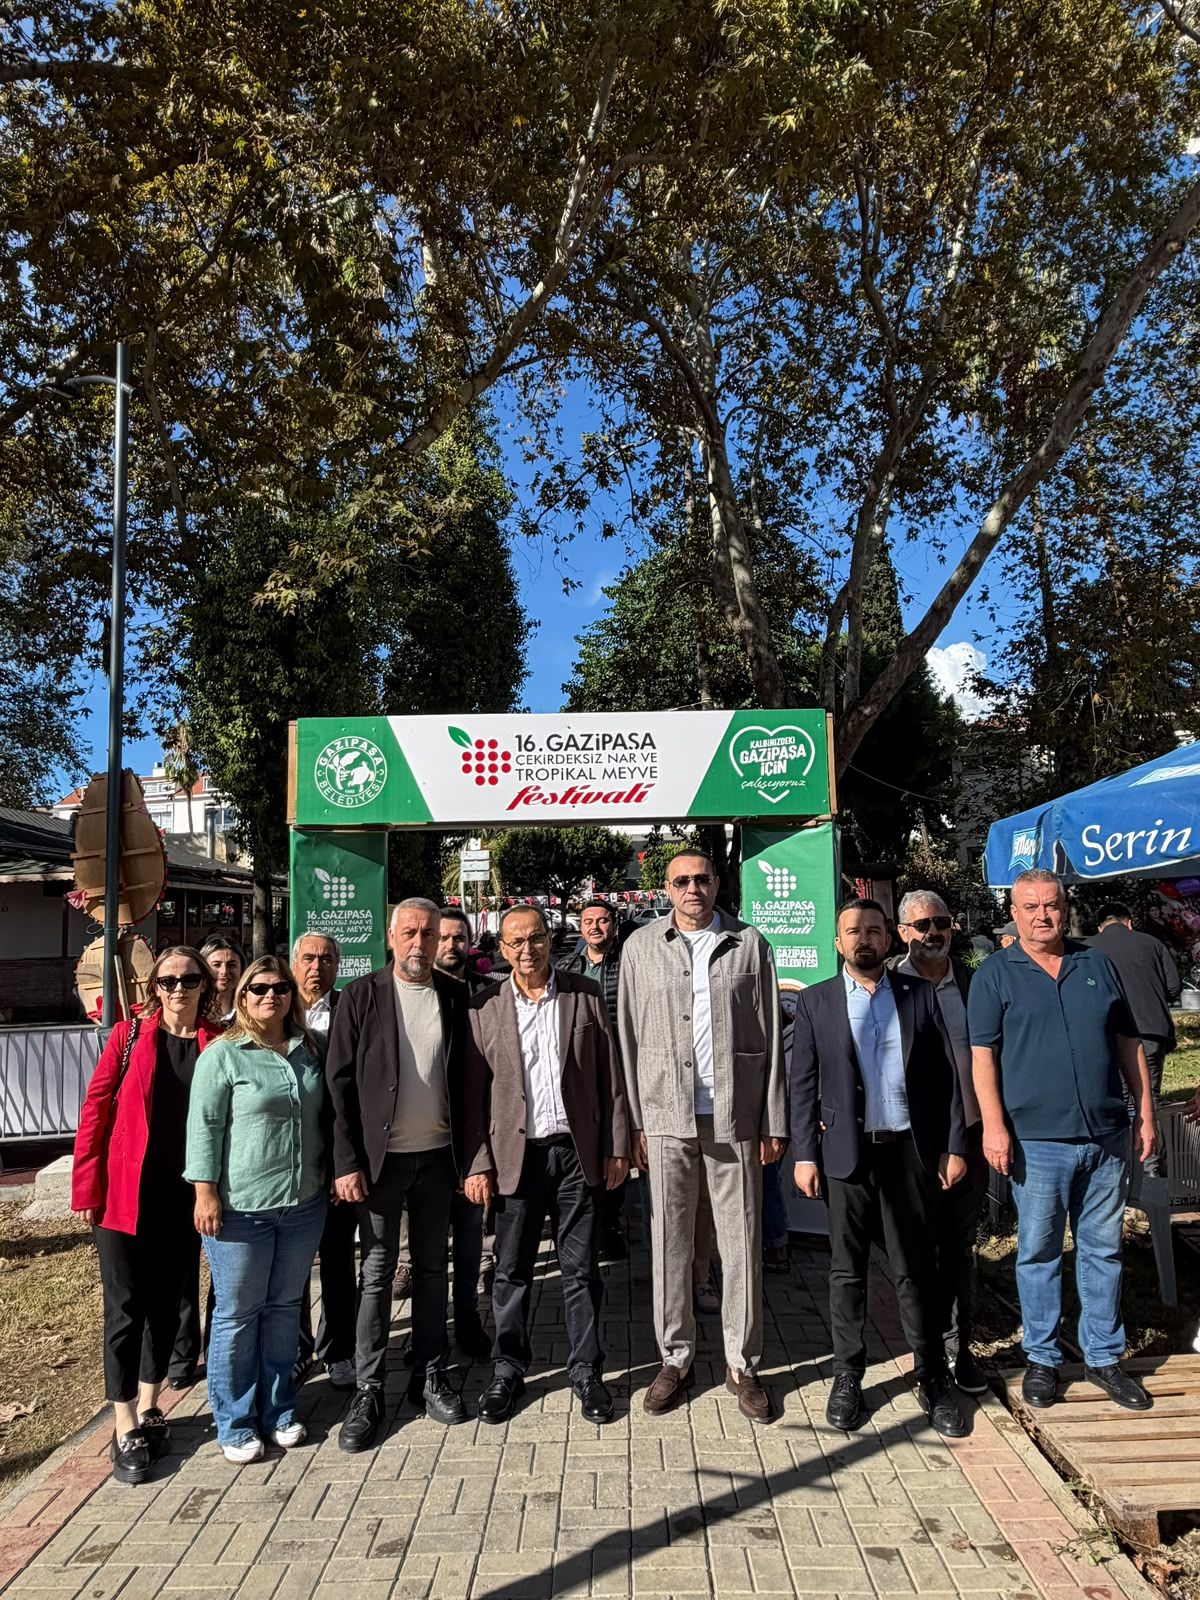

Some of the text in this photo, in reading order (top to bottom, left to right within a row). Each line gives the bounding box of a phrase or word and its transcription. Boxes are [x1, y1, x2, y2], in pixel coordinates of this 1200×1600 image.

[515, 752, 658, 766] ÇEKİRDEKSİZ NAR VE
[740, 744, 807, 764] GAZİPAŞA
[515, 766, 658, 781] TROPİKAL MEYVE
[760, 760, 788, 776] İÇİN
[505, 782, 656, 811] festivali
[1081, 819, 1192, 866] Serin
[789, 916, 816, 924] MEYVE
